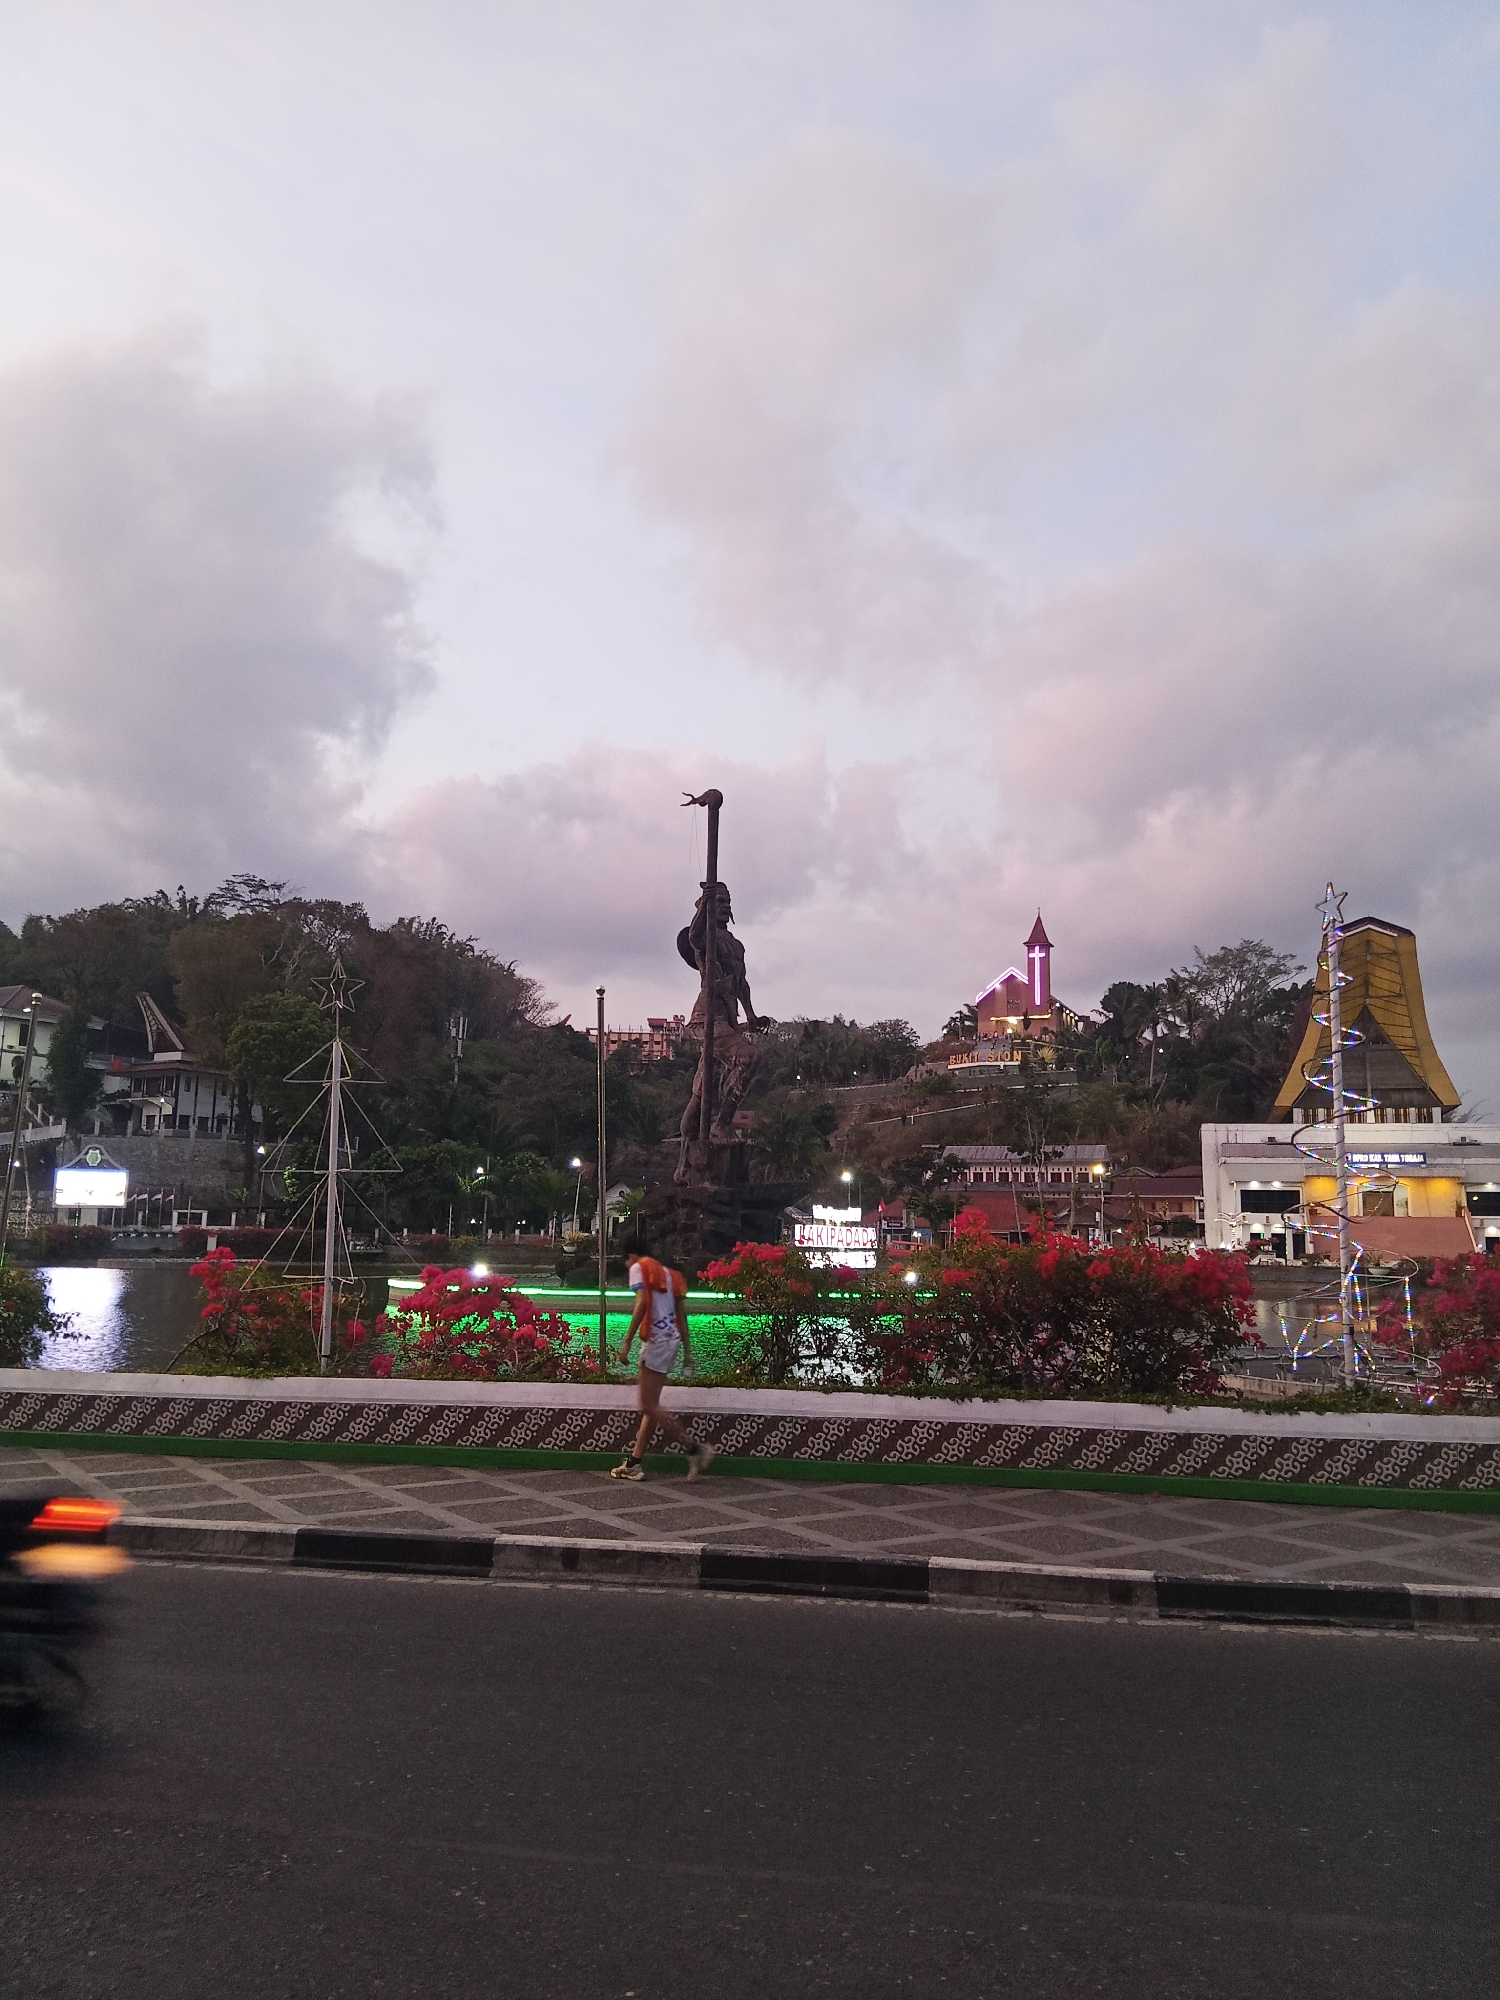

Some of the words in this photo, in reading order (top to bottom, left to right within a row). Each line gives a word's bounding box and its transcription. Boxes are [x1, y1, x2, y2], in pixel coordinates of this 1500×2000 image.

[949, 1051, 979, 1065] BUKIT
[987, 1050, 1022, 1062] SION
[1401, 1154, 1424, 1163] TORAJA
